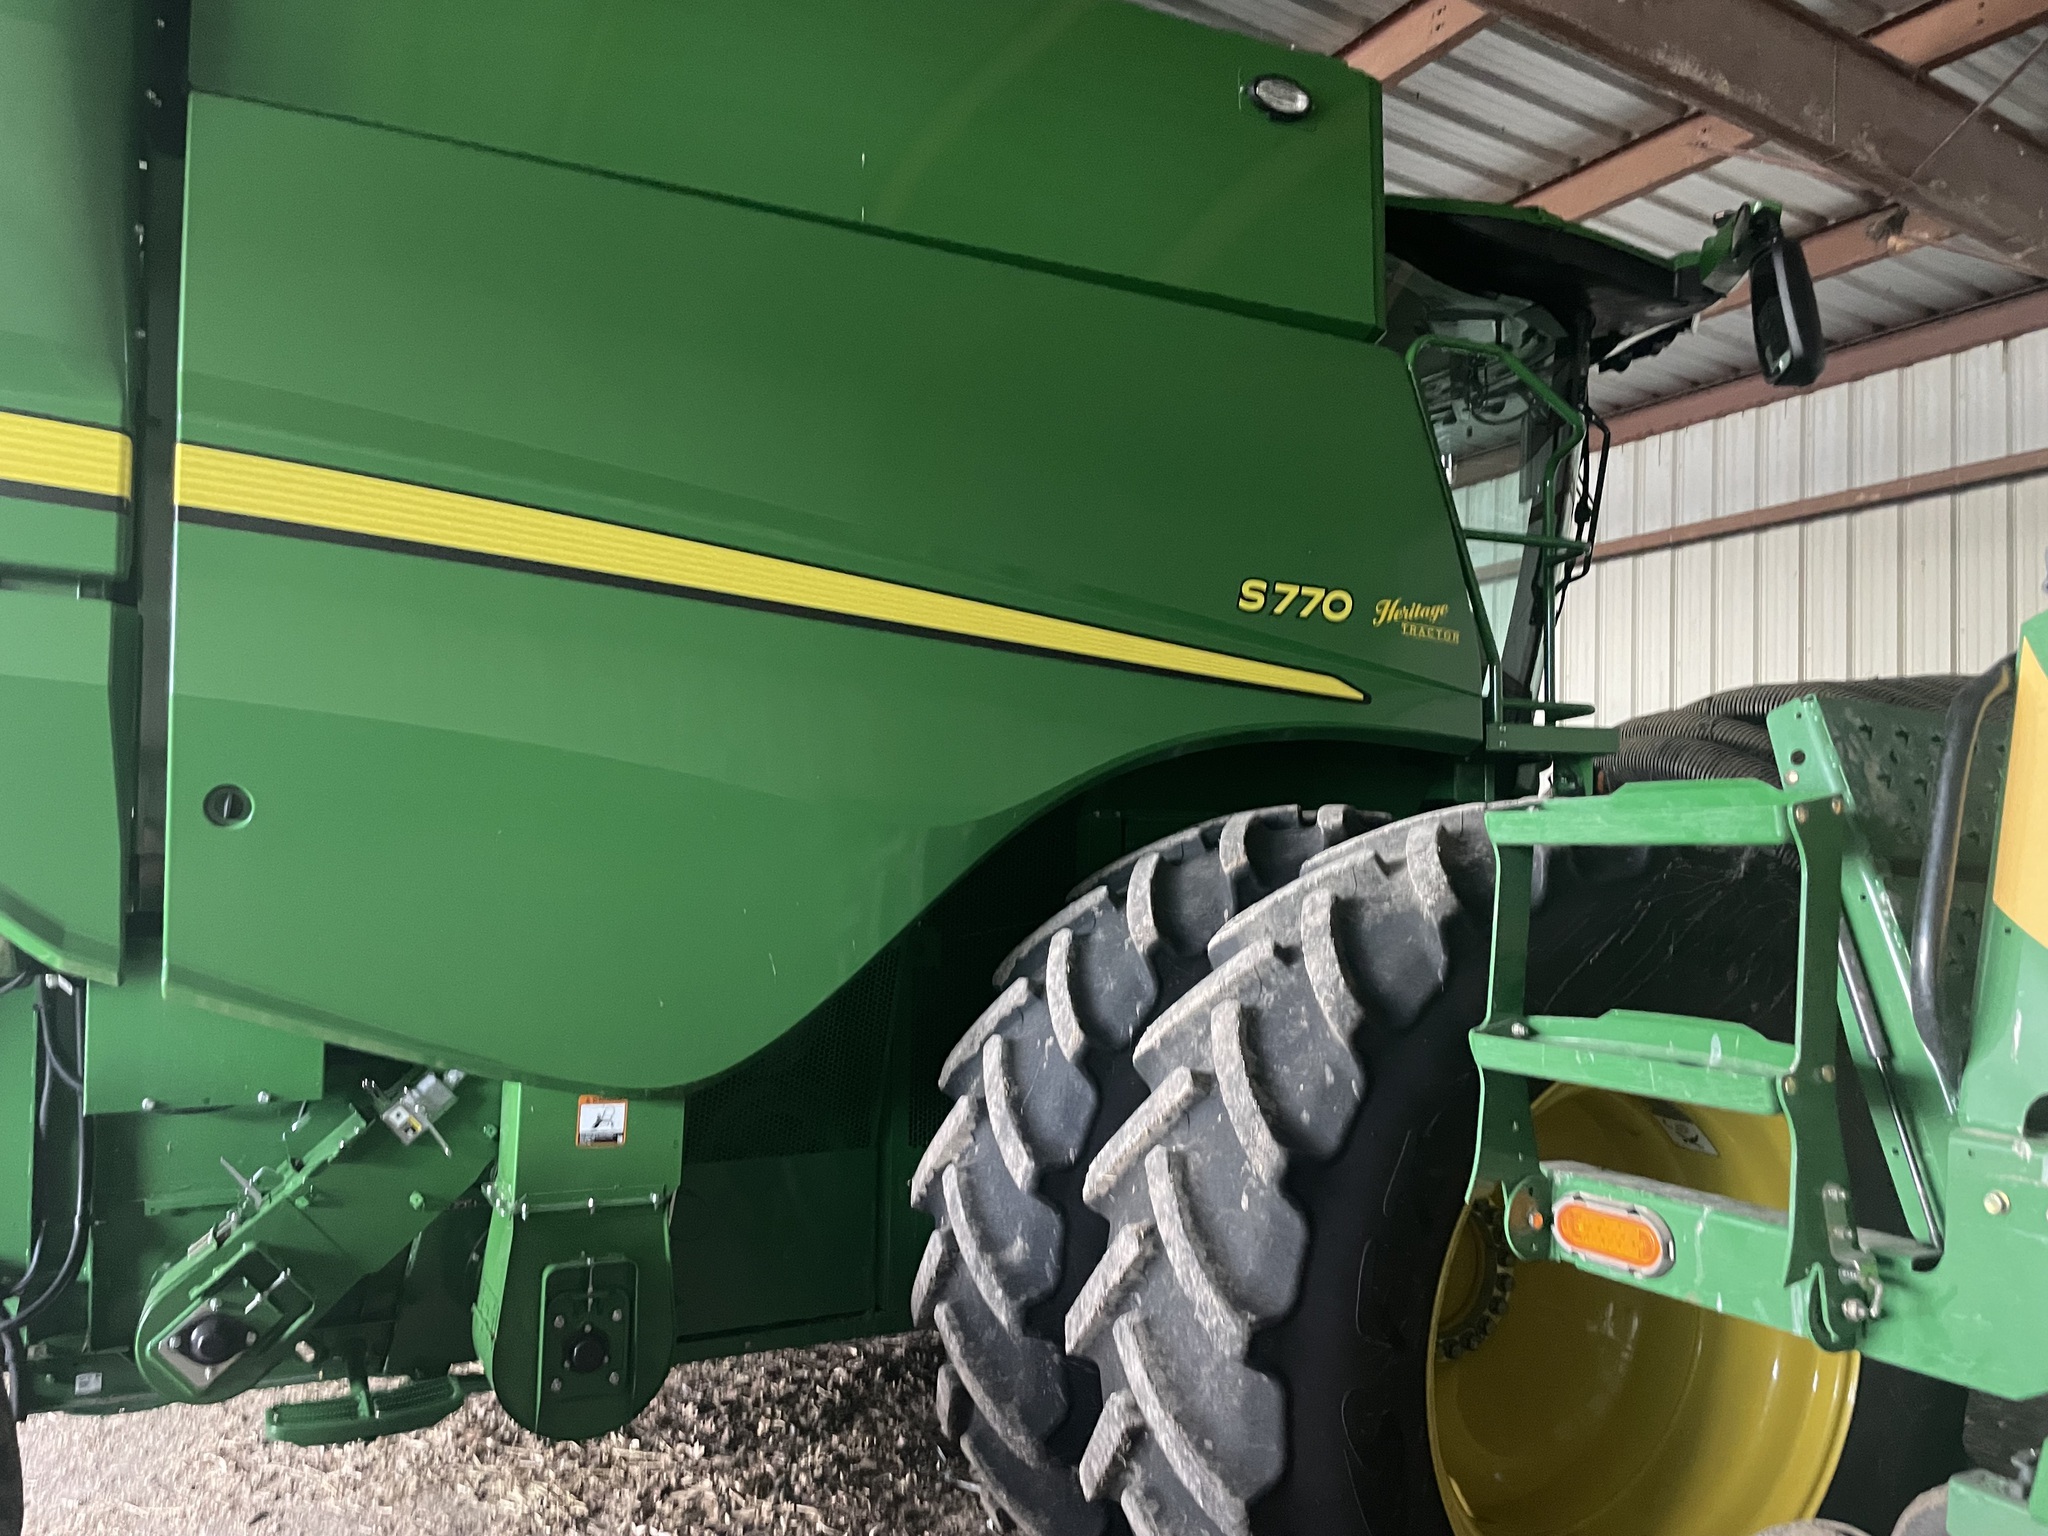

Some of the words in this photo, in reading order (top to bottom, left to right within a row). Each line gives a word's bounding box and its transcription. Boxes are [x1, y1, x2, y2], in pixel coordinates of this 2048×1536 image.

[1238, 578, 1354, 623] S770
[1372, 597, 1449, 628] Heritage
[1401, 621, 1461, 646] TRACTOR
